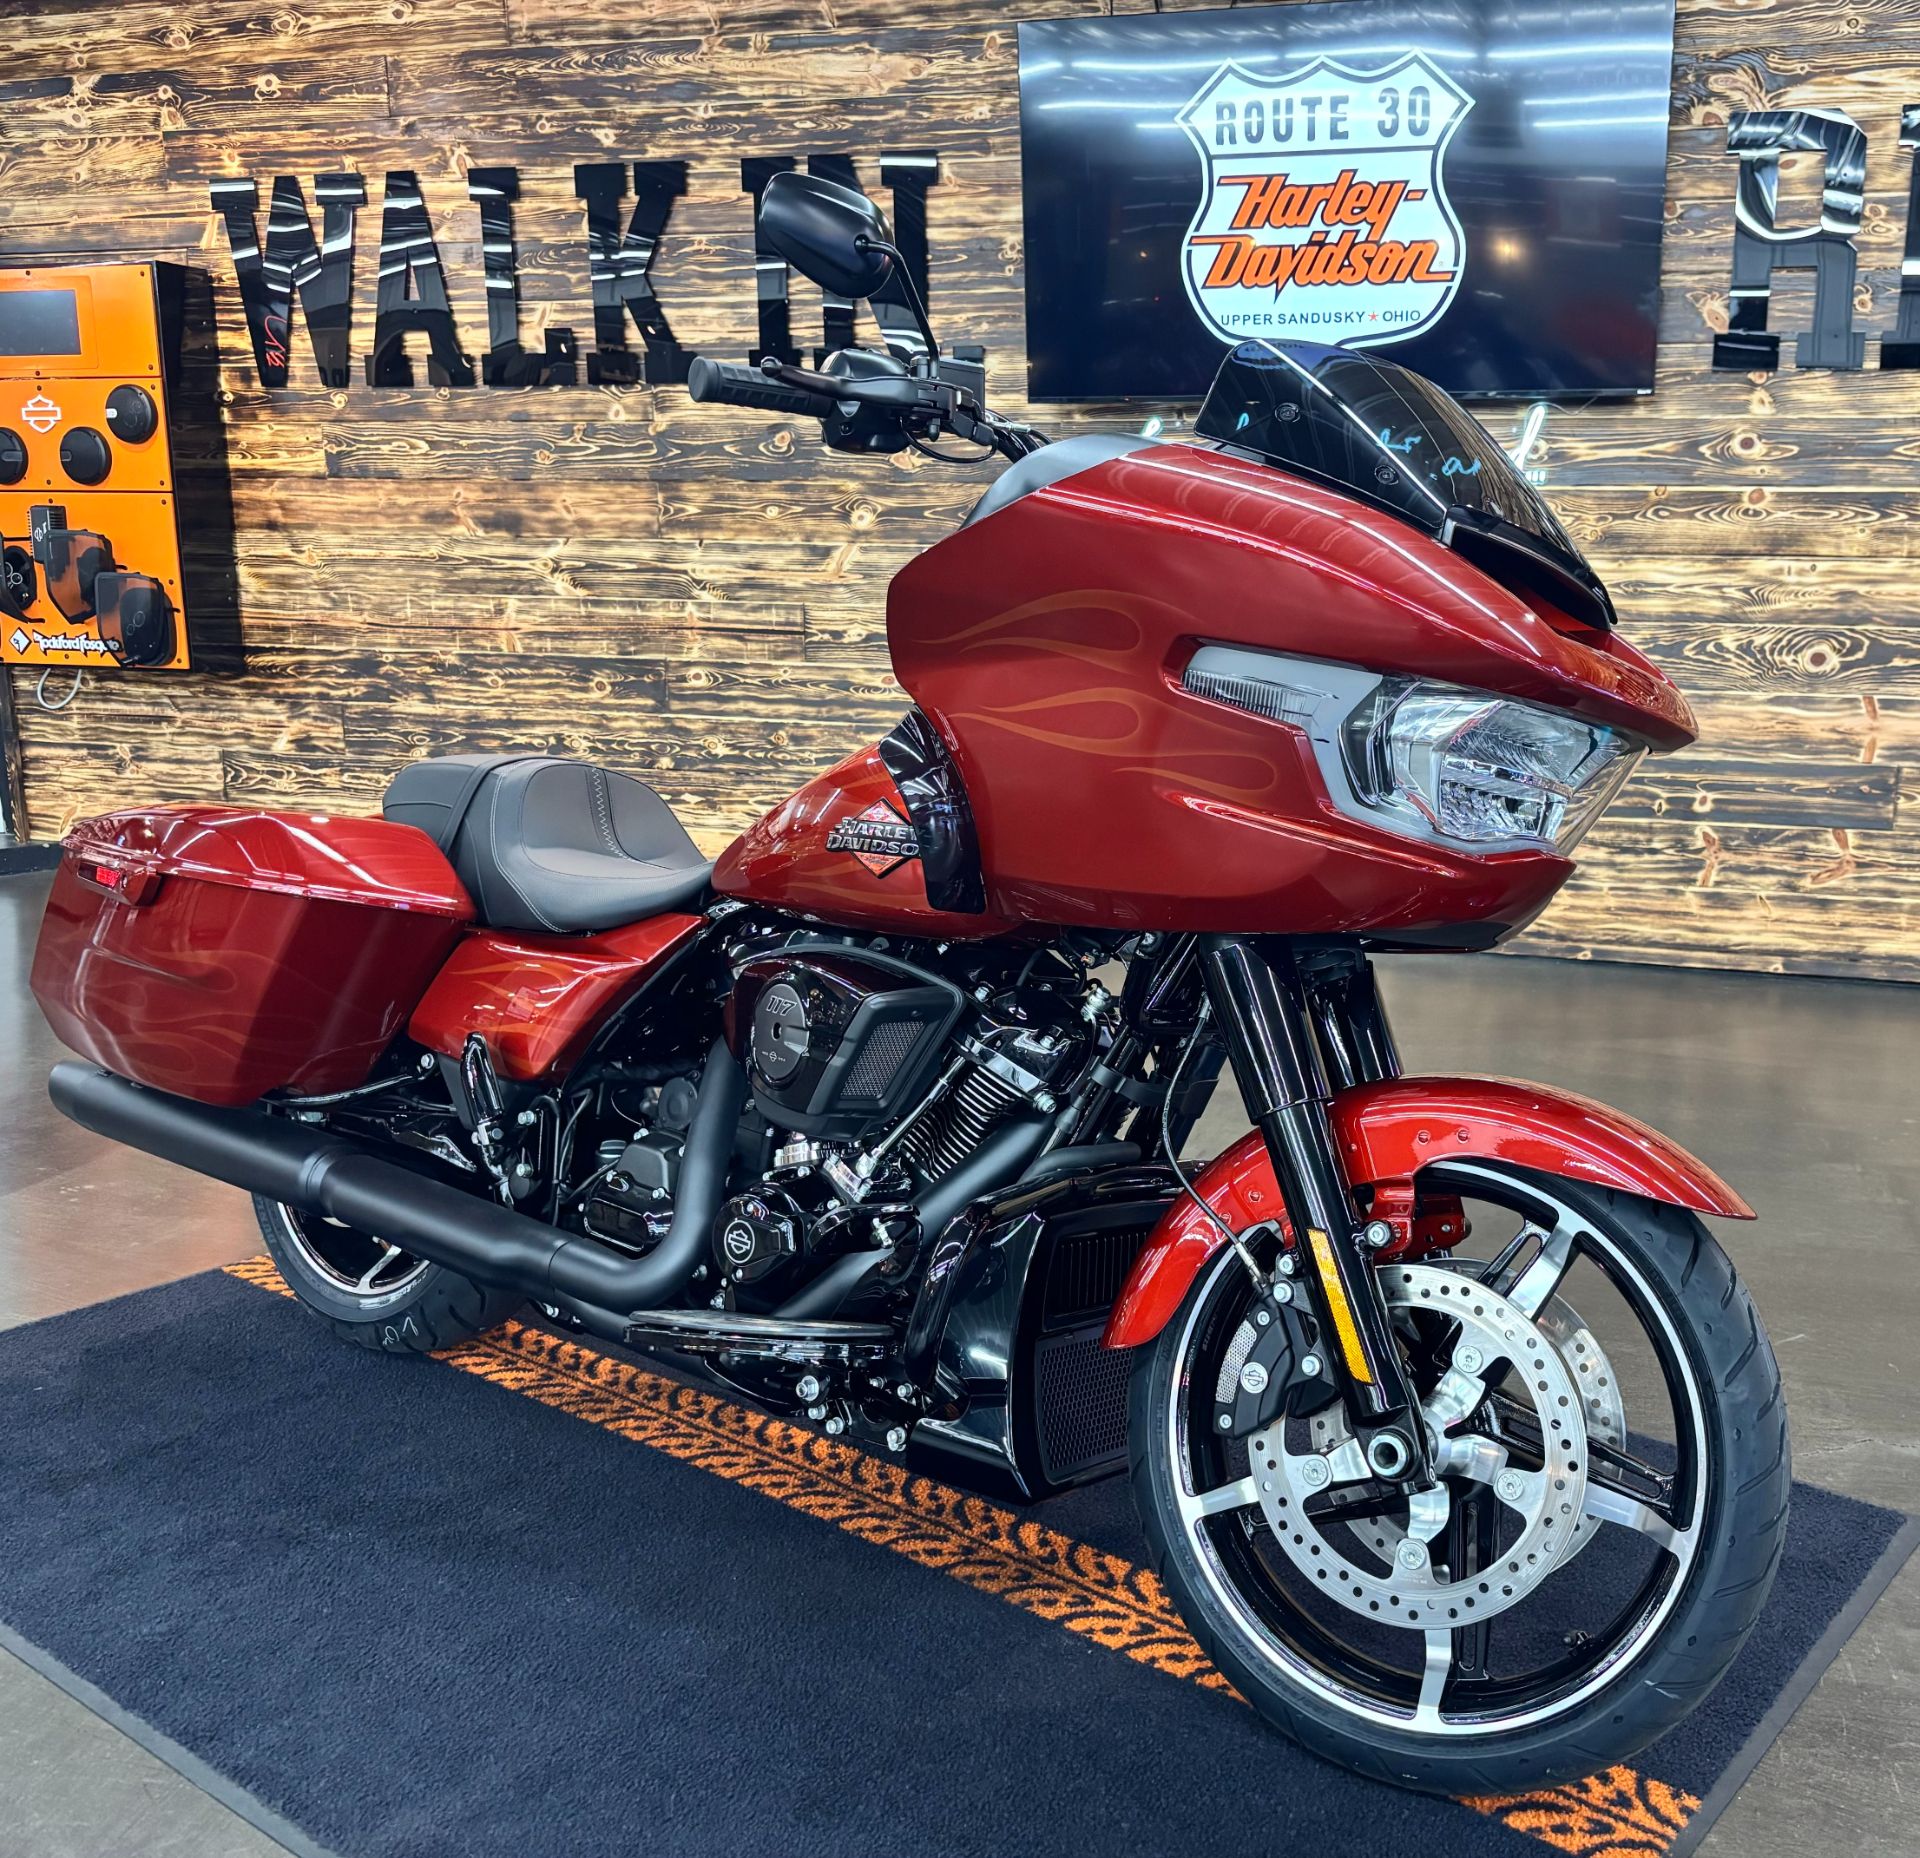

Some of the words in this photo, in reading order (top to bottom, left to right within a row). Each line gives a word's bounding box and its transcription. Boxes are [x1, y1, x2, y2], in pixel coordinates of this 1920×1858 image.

[1215, 95, 1349, 146] ROUTE
[1377, 86, 1431, 138] 30
[1217, 168, 1428, 240] Harley-
[209, 161, 700, 387] WALK
[1188, 230, 1457, 304] Davidson
[1220, 313, 1273, 326] UPPER
[1277, 311, 1366, 325] SANDUSKY
[1382, 309, 1421, 322] OHIO
[826, 831, 919, 856] DAVIDSO
[766, 995, 798, 1016] 117
